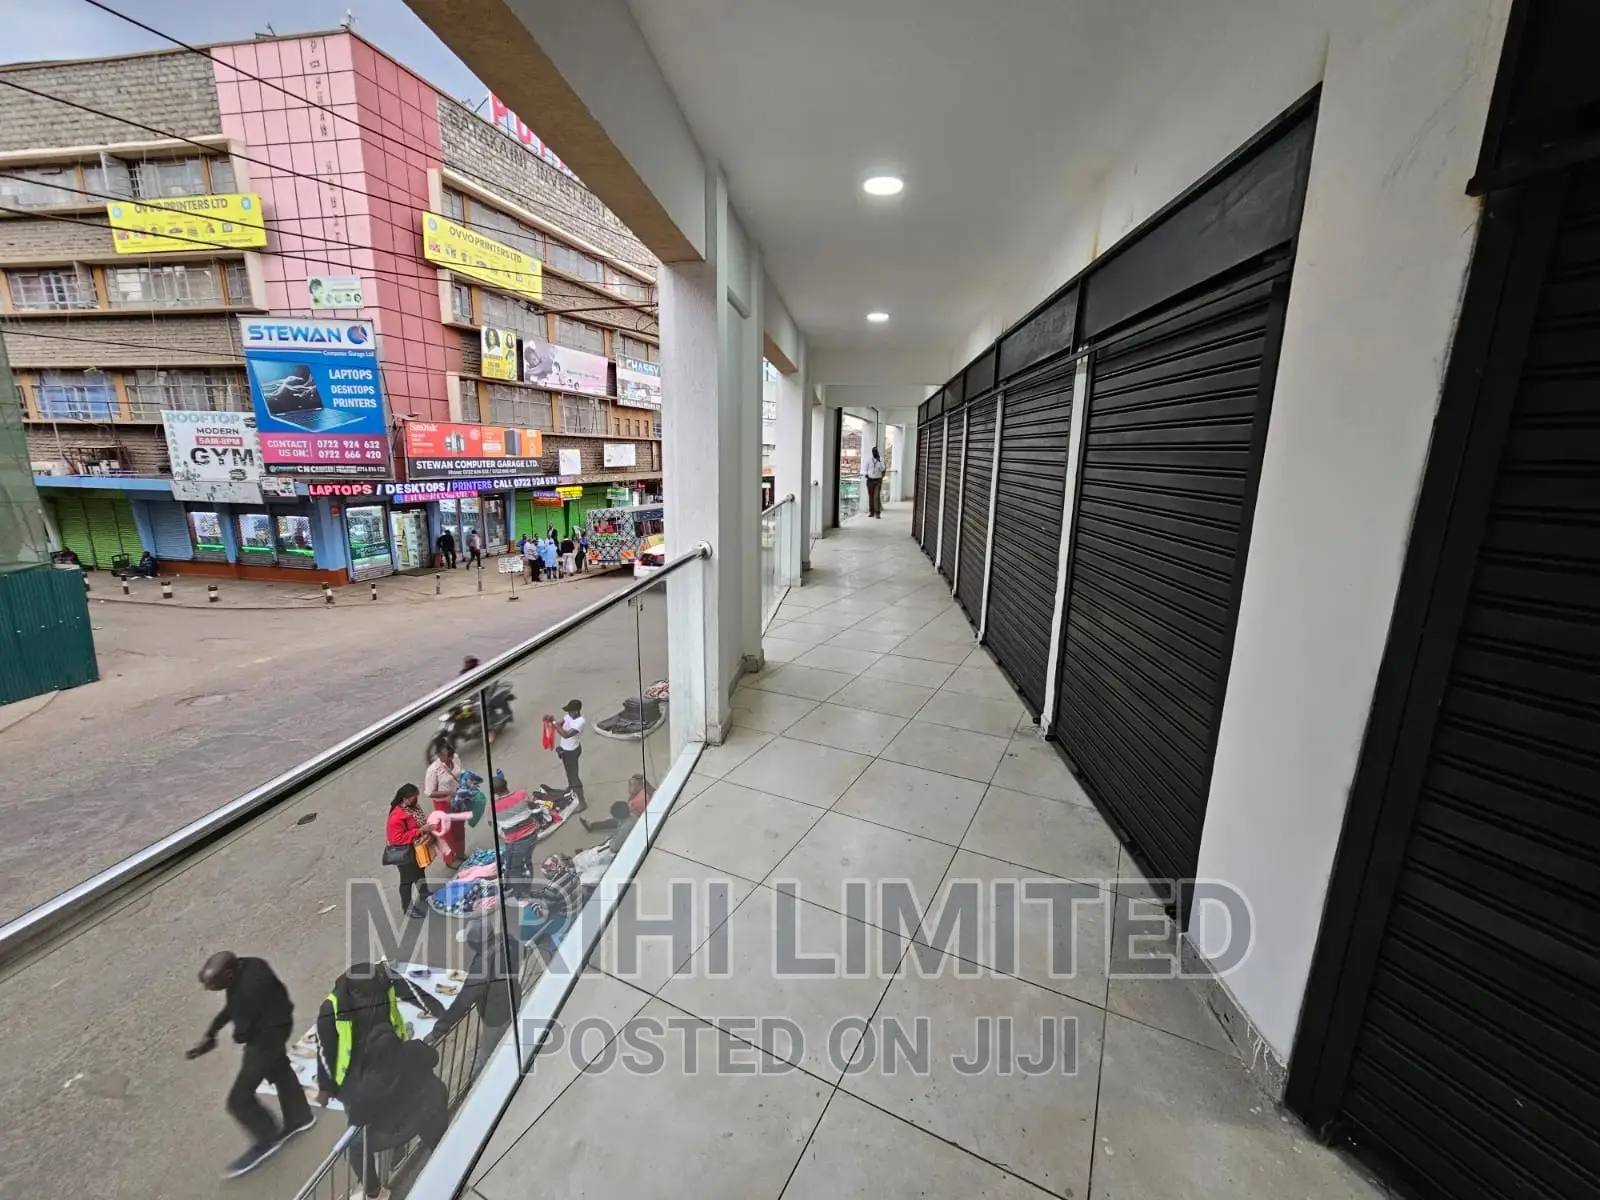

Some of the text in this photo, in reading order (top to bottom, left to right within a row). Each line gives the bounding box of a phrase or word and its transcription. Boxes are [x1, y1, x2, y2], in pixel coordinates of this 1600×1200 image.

[163, 199, 210, 212] PRINTERS
[211, 198, 228, 209] LTD
[448, 226, 522, 264] OVVO PRINTERS LTD
[247, 324, 342, 343] STEWAN
[328, 369, 373, 380] LAPTOPS
[331, 385, 375, 394] DESKTOPS
[333, 398, 377, 408] PRINTERS
[165, 412, 240, 424] ROOFTOP
[196, 427, 239, 435] MODERN
[267, 440, 380, 449] CONTACT 0722 924 632
[190, 447, 255, 466] GYM
[278, 449, 290, 457] US
[318, 450, 340, 459] 0722
[344, 450, 361, 459] 666
[365, 450, 381, 459] 420
[416, 459, 539, 470] STEWAN COMPUTER GARAGE LTD.
[309, 484, 373, 495] LAPTOPS
[385, 481, 445, 495] DESKTOPS
[452, 480, 493, 491] PRINTERS
[493, 478, 513, 488] CALL
[514, 477, 531, 487] 0722
[532, 477, 545, 486] 924
[545, 476, 557, 485] 632
